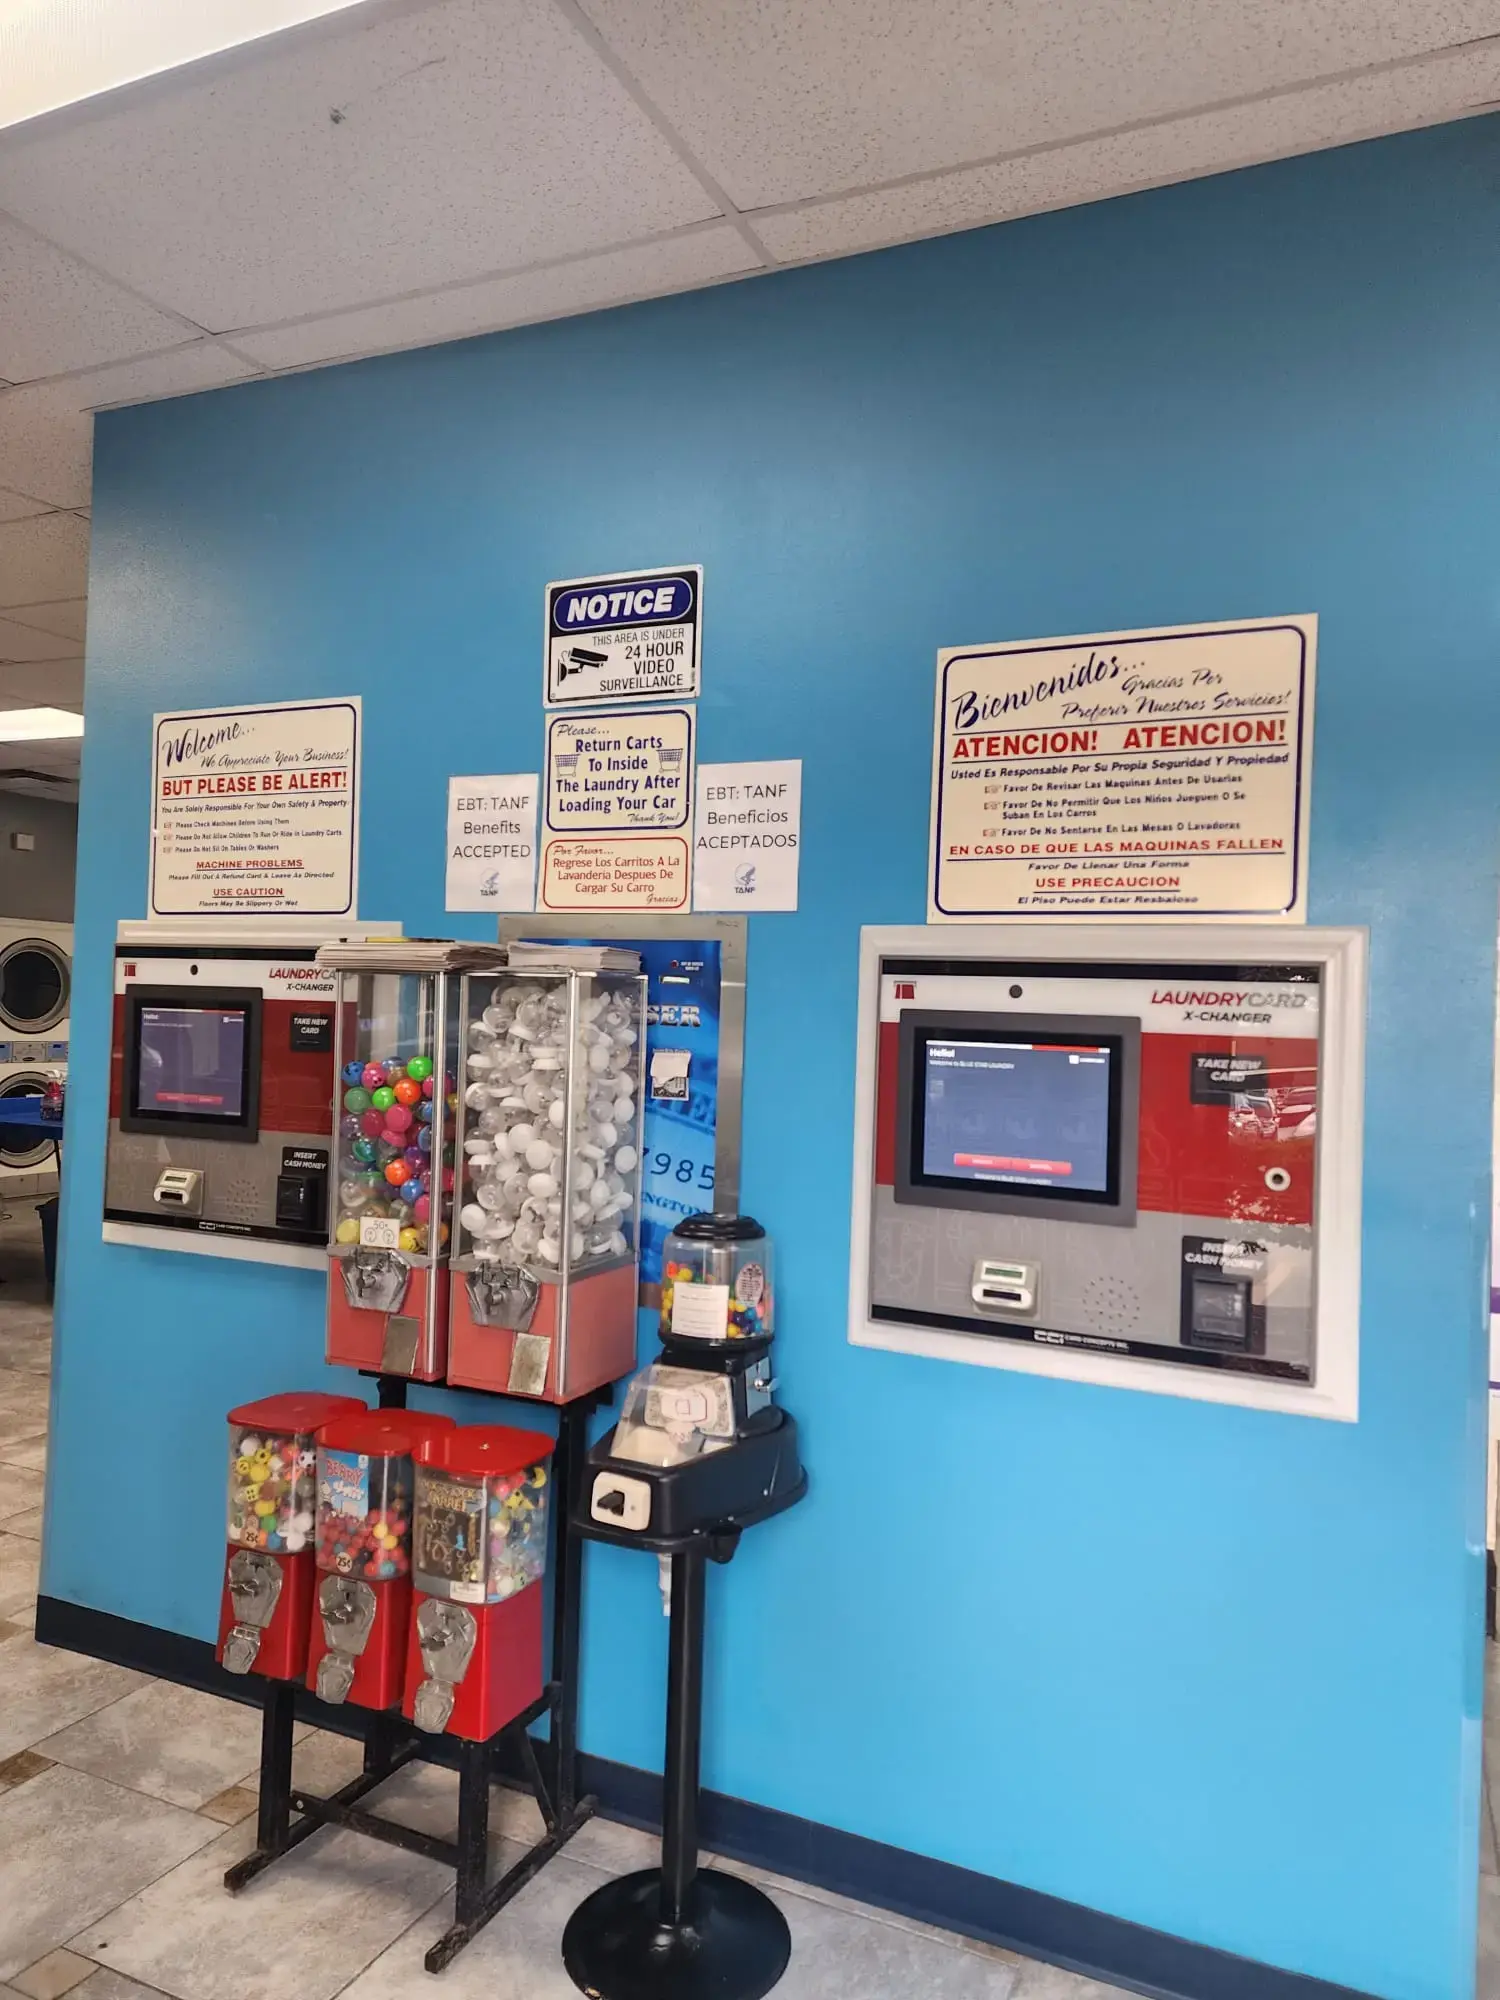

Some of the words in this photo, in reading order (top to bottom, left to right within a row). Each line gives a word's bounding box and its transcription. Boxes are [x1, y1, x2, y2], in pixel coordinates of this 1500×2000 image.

[567, 587, 676, 622] NOTICE
[592, 635, 611, 646] THIS
[615, 632, 637, 643] AREA
[641, 631, 649, 640] IS
[652, 628, 684, 640] UNDER
[625, 646, 640, 660] 24
[646, 641, 683, 657] HOUR
[634, 658, 674, 674] VIDEO
[600, 674, 683, 691] SURVEILLANCE
[1122, 675, 1184, 695] Gracias
[1192, 667, 1223, 686] Por
[1136, 695, 1205, 713] Nuestros
[1213, 689, 1291, 711] Servicios!
[576, 739, 621, 752] Return
[627, 736, 662, 750] Carts
[953, 730, 1098, 758] ATENCION!
[1123, 719, 1285, 749] ATENCION!
[200, 756, 216, 768] We
[219, 755, 270, 769] Appreciate
[275, 750, 298, 766] Your
[303, 748, 349, 762] Business!
[589, 758, 601, 772] To
[607, 756, 648, 770] Inside
[951, 769, 980, 779] Usted
[984, 769, 996, 778] Es
[1000, 765, 1068, 778] Responsable
[1072, 764, 1089, 773] Por
[1094, 763, 1108, 772] Su
[1112, 762, 1147, 771] Propia
[1152, 757, 1211, 769] Seguridad
[1216, 756, 1223, 765] Y
[1227, 753, 1289, 765] Propiedad
[162, 780, 192, 795] BUT
[197, 777, 256, 794] PLEASE
[262, 775, 282, 791] BE
[288, 772, 347, 789] ALERT!
[556, 779, 579, 793] The
[584, 776, 639, 793] Laundry
[644, 776, 680, 789] After
[1004, 784, 1028, 792] Favor
[1032, 783, 1042, 791] De
[1047, 782, 1081, 790] Revisar
[1085, 781, 1100, 789] Las
[1105, 778, 1151, 789] Maquinas
[1154, 777, 1183, 785] Antes
[1188, 776, 1199, 784] De
[707, 787, 739, 800] EBT:
[744, 784, 787, 798] TANF
[1047, 799, 1058, 807] No
[1062, 797, 1099, 806] Permitir
[1103, 797, 1120, 805] Que
[1125, 796, 1141, 804] Los
[1176, 794, 1218, 802] Jueguen
[1223, 792, 1230, 800] O
[1234, 792, 1246, 800] Se
[185, 805, 202, 813] Solely
[205, 803, 241, 812] Responsible
[319, 800, 346, 808] Property
[457, 798, 488, 811] EBT:
[491, 797, 529, 810] TANF
[559, 797, 611, 813] Loading
[616, 797, 647, 810] Your
[653, 795, 676, 809] Car
[628, 813, 655, 823] Thank
[657, 812, 679, 823] You!
[708, 809, 788, 824] Beneficios
[1003, 811, 1029, 820] Suban
[1048, 810, 1063, 818] Los
[464, 821, 520, 834] Benefits
[1002, 828, 1027, 836] Favor
[1030, 827, 1041, 835] De
[1045, 826, 1057, 834] No
[1061, 825, 1102, 834] Sentarse
[1122, 824, 1137, 832] Las
[1142, 824, 1173, 832] Mesas
[1177, 822, 1184, 830] O
[1188, 821, 1240, 830] Lavadoras
[697, 834, 797, 849] ACEPTADOS
[950, 846, 969, 855] EN
[974, 845, 1014, 854] CASO
[1021, 844, 1040, 853] DE
[1046, 843, 1078, 853] QUE
[1084, 842, 1113, 852] LAS
[1120, 839, 1210, 851] MAQUINAS
[1217, 839, 1283, 849] FALLEN
[453, 845, 530, 858] ACCEPTED
[197, 861, 242, 869] MACHINE
[553, 858, 592, 869] Regrese
[595, 858, 611, 867] Los
[615, 857, 653, 866] Carritos
[658, 857, 664, 865] A
[668, 856, 679, 865] La
[558, 871, 611, 880] Lavanderia
[614, 870, 656, 881] Despues
[660, 869, 673, 878] De
[1036, 878, 1066, 887] USE
[1072, 877, 1180, 887] PRECAUCION
[213, 888, 232, 896] USE
[576, 883, 607, 894] Cargar
[611, 883, 623, 892] Su
[627, 883, 654, 892] Carro
[287, 983, 333, 991] X-CHANGER
[1183, 1011, 1272, 1023] X-CHANGER
[1197, 1058, 1228, 1069] TAKE
[1231, 1060, 1261, 1070] NEW
[643, 1147, 714, 1190] 985
[1184, 1253, 1219, 1265] CASH
